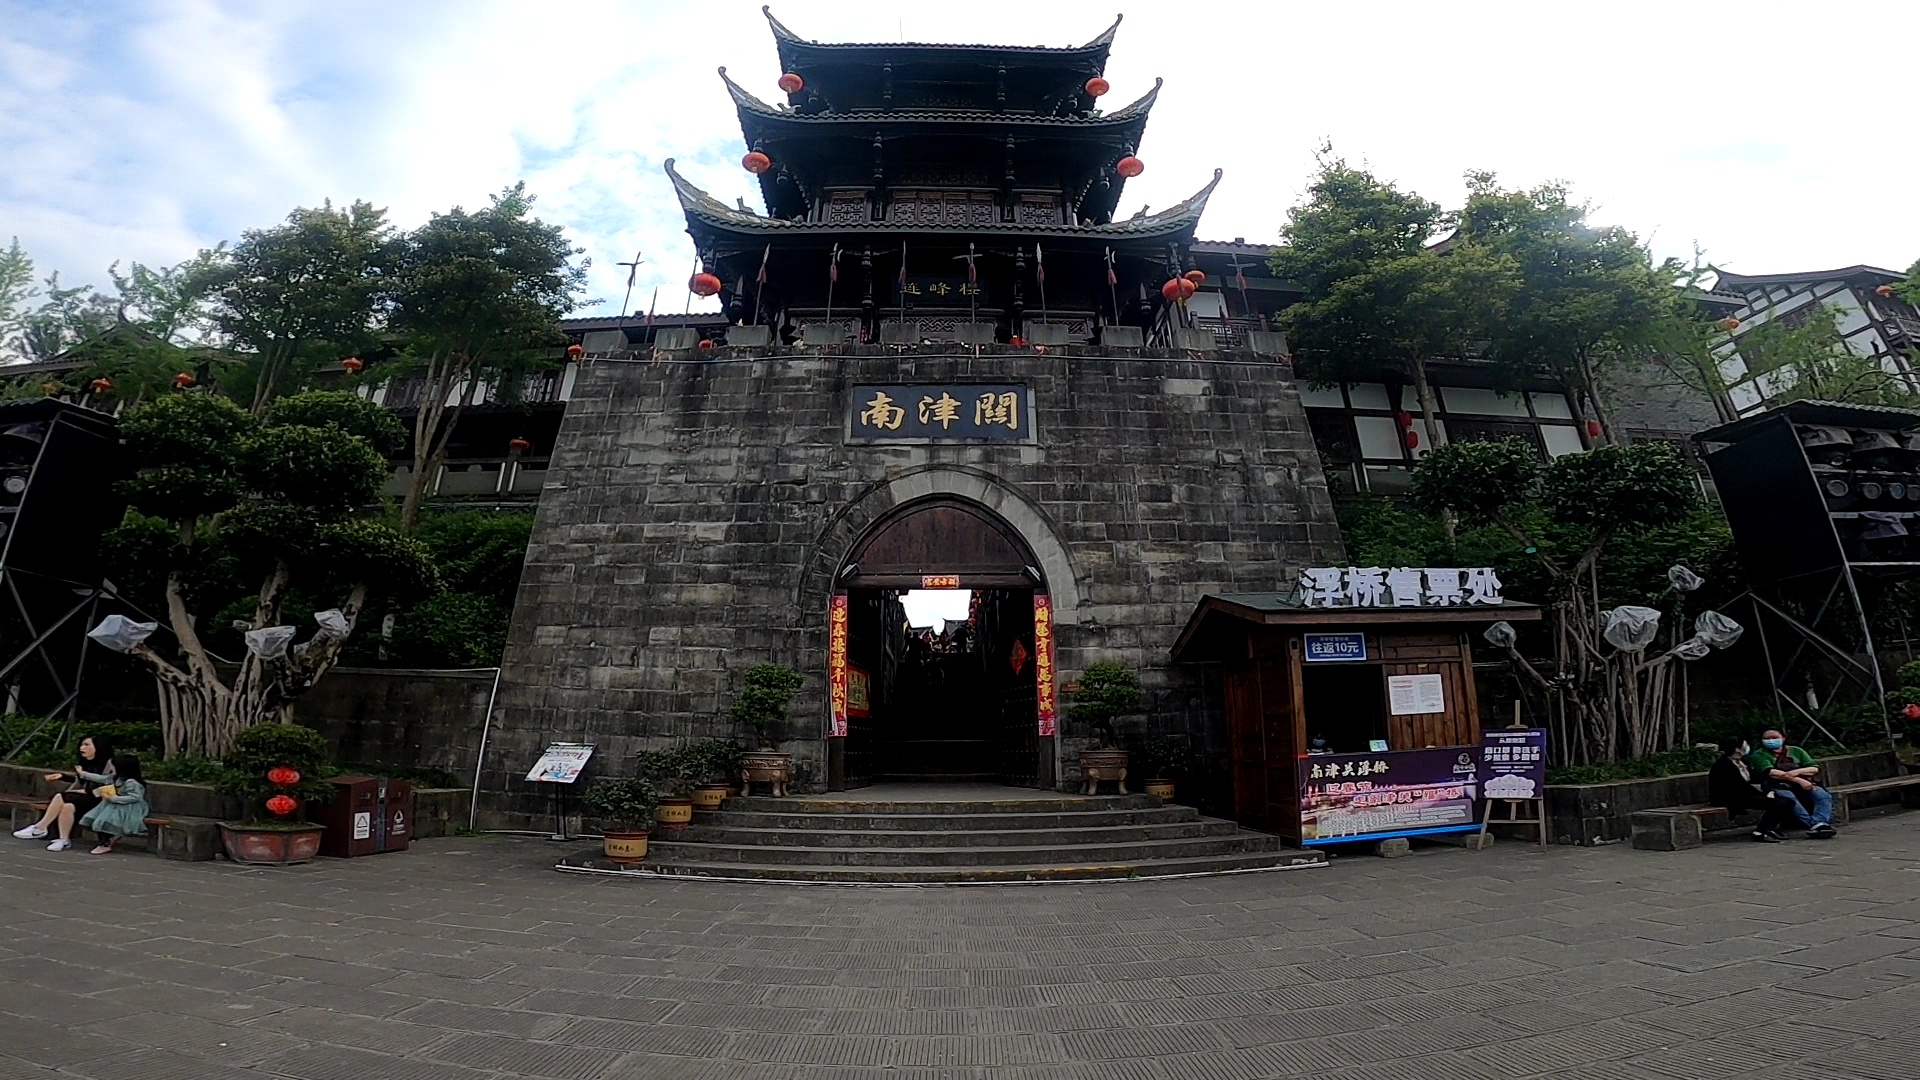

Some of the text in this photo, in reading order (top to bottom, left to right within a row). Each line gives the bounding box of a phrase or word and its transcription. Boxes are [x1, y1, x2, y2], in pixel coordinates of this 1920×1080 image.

[1300, 566, 1504, 607] 浮桥售票处
[1311, 641, 1359, 654] 往返10元
[1310, 760, 1389, 779] 南津关浮桥
